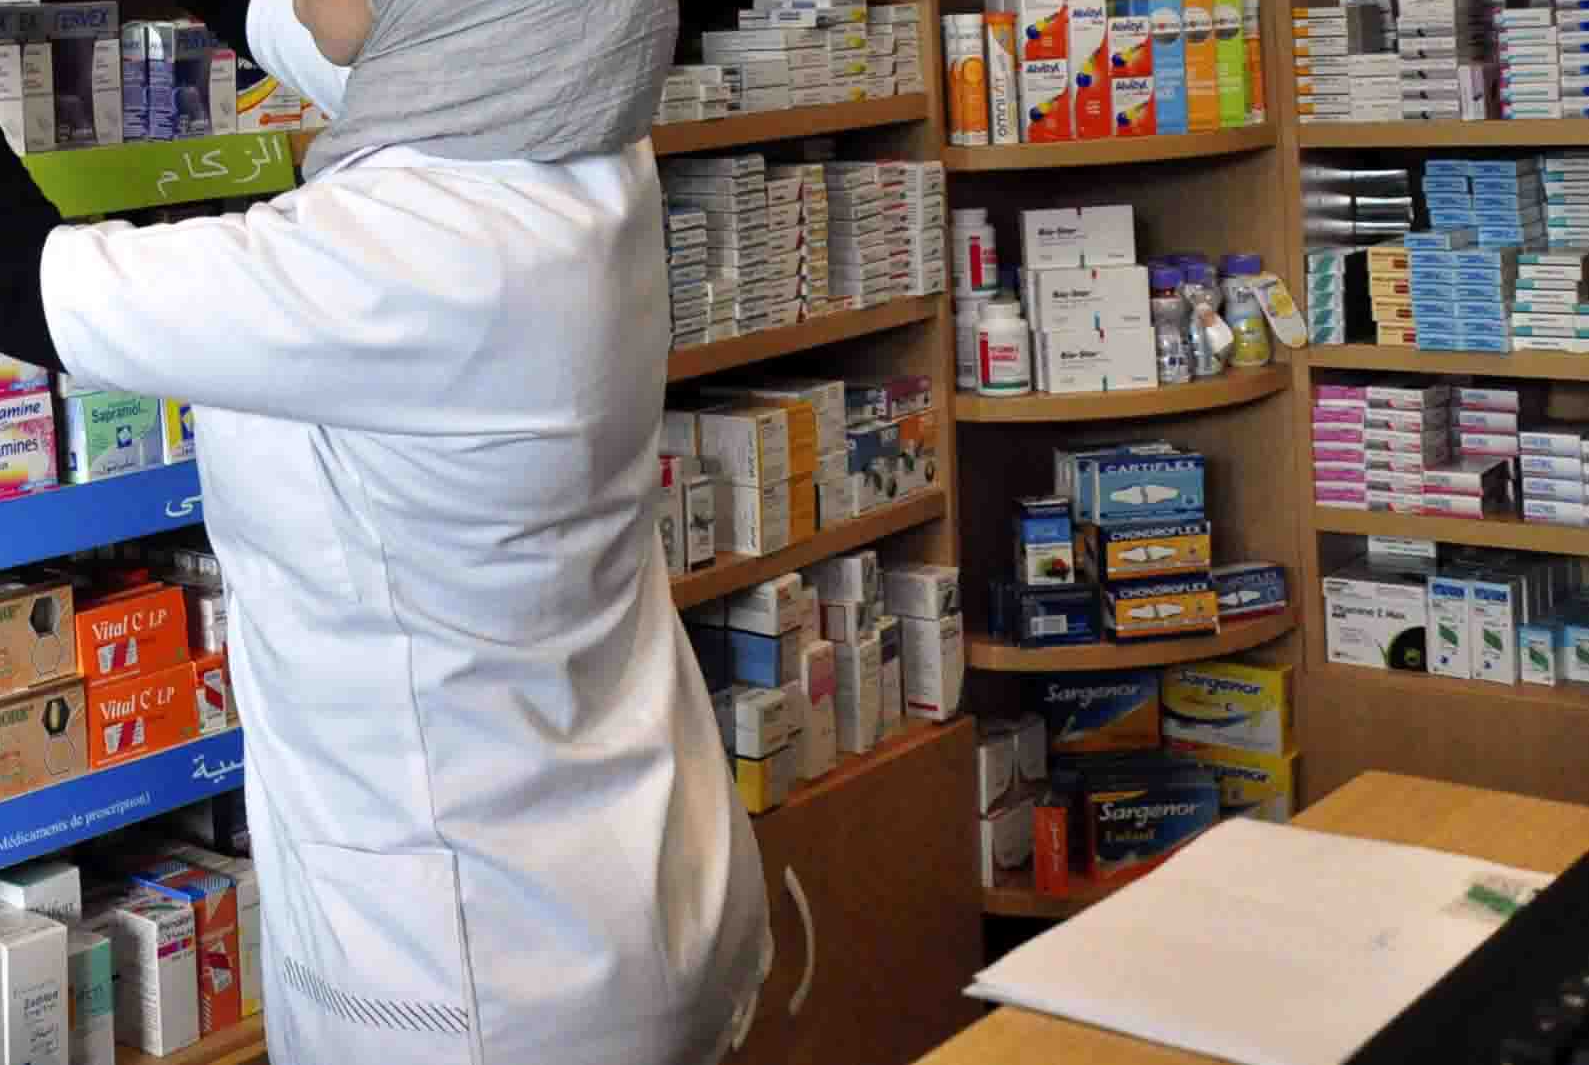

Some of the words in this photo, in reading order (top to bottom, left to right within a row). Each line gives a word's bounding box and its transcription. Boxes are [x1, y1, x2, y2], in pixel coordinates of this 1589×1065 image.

[155, 136, 285, 200] الزكام
[91, 618, 130, 640] Vital
[132, 612, 142, 632] C
[148, 609, 167, 627] LP
[1044, 683, 1141, 708] Sargenor
[1178, 669, 1264, 696] Sargenor
[100, 697, 137, 720] Vital
[139, 688, 152, 710] C
[157, 686, 175, 705] LP
[70, 813, 83, 830] de
[85, 791, 152, 827] prescription)
[1098, 801, 1201, 829] Sargenor
